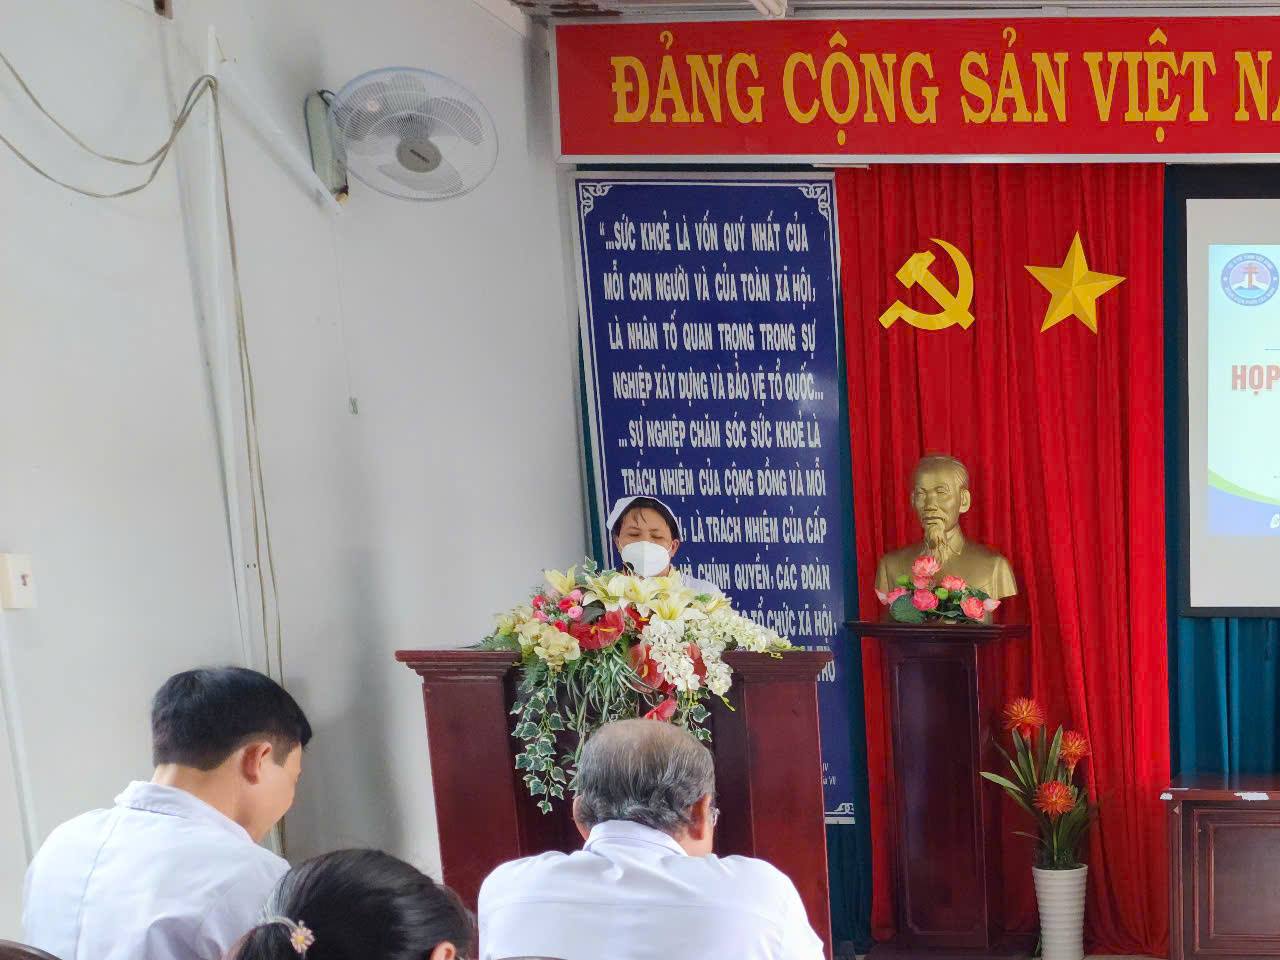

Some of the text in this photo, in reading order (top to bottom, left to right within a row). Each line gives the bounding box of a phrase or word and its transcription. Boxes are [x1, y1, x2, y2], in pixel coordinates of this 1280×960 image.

[611, 31, 764, 123] ĐẢNG
[783, 31, 939, 145] CỘNG
[960, 27, 1068, 123] SẢN
[1084, 28, 1216, 142] VIỆT
[676, 210, 808, 253] LÀ VỐN QUÝ NHẤT CỦA
[604, 260, 815, 310] MỖI CON NGƯỜI VÀ CỦA TOÀN XÃ HỘI,
[608, 309, 816, 359] LÀ NHÂN TỐ QUAN TRỌNG TRONG SỰ
[613, 358, 824, 407] NGHIỆP XÂY DỰNG VÀ BẢO VỆ TỔ QUỐC...
[1232, 365, 1280, 395] HỌP
[646, 412, 821, 454] NGHIỆP CHĂM SÓC SỨC LÀ
[621, 457, 826, 505] TRÁCH NHIỆM CỦA CỘNG ĐỒNG VÀ MỖI
[735, 553, 830, 590] QUYỀN, CÁC ĐOÀN
